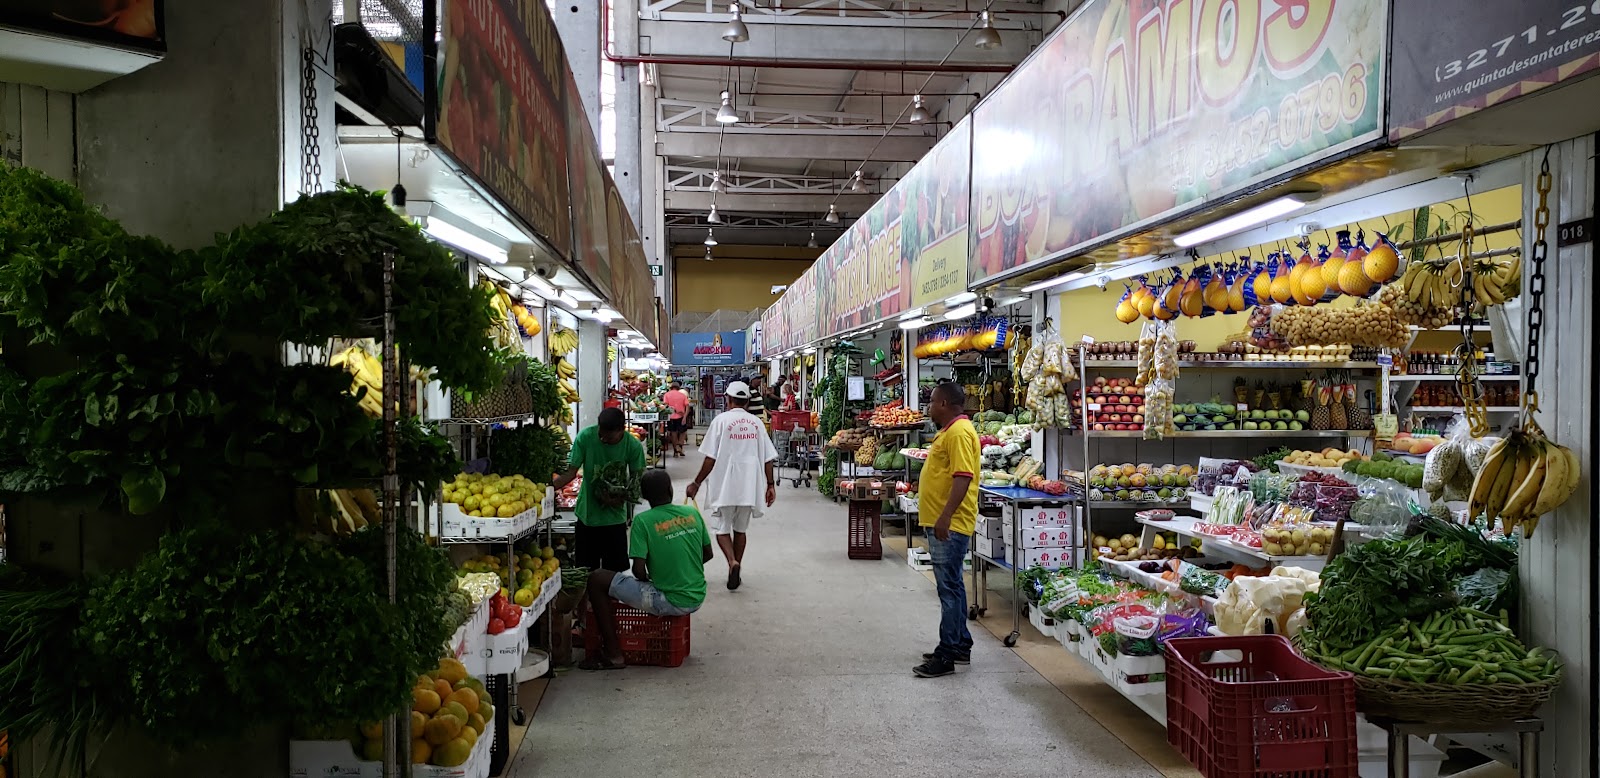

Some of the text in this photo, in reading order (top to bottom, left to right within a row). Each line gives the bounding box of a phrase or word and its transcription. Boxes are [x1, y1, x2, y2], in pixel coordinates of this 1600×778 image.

[511, 41, 518, 84] E
[1063, 0, 1337, 187] RAMOS
[1203, 62, 1368, 180] 3452-0796
[482, 145, 494, 183] 71
[1561, 225, 1584, 240] 018
[867, 220, 901, 304] JORGE
[932, 257, 947, 272] Delivery
